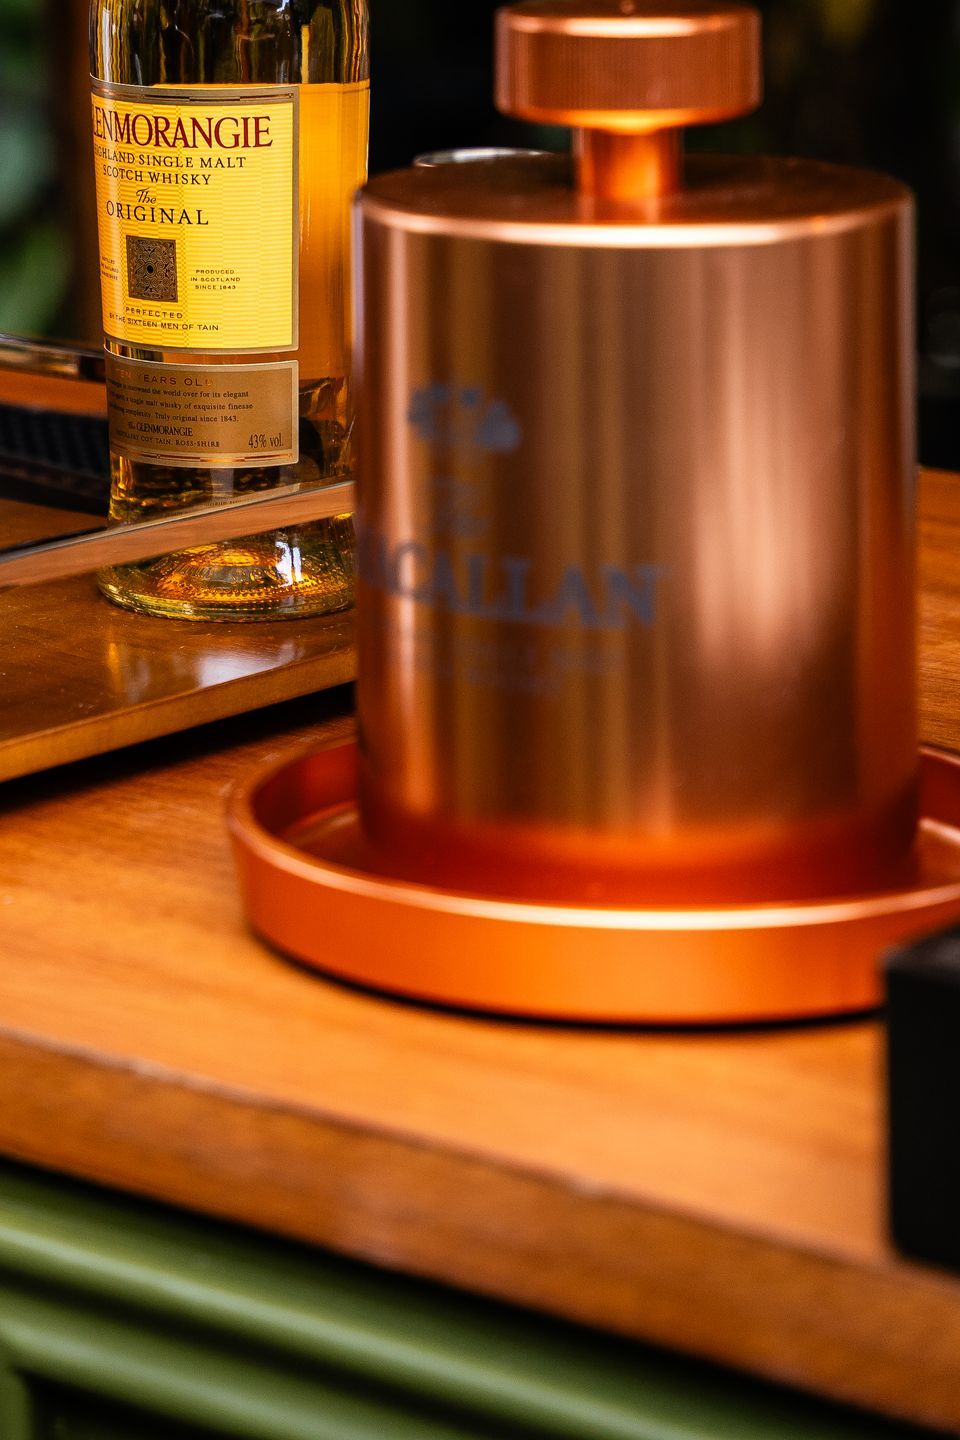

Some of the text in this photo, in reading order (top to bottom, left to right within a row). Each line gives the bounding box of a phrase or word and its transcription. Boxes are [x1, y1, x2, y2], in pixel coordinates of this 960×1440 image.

[94, 106, 274, 149] ENMORANGIE
[138, 154, 194, 168] SINGLE
[200, 157, 246, 168] MALT
[103, 164, 212, 185] SCOTCH WHISKY
[136, 187, 157, 205] The
[106, 200, 209, 225] ORIGINAL
[125, 306, 183, 319] PERFECTED
[127, 317, 158, 328] SIXTEEN
[160, 322, 179, 330] MEN
[163, 389, 181, 397] world
[223, 391, 249, 400] elegant
[160, 402, 182, 410] whisky
[193, 404, 226, 412] exquisite
[155, 412, 170, 420] Truly
[172, 414, 198, 423] original
[136, 422, 193, 437] GLENMORANGIE
[248, 433, 267, 449] 43%
